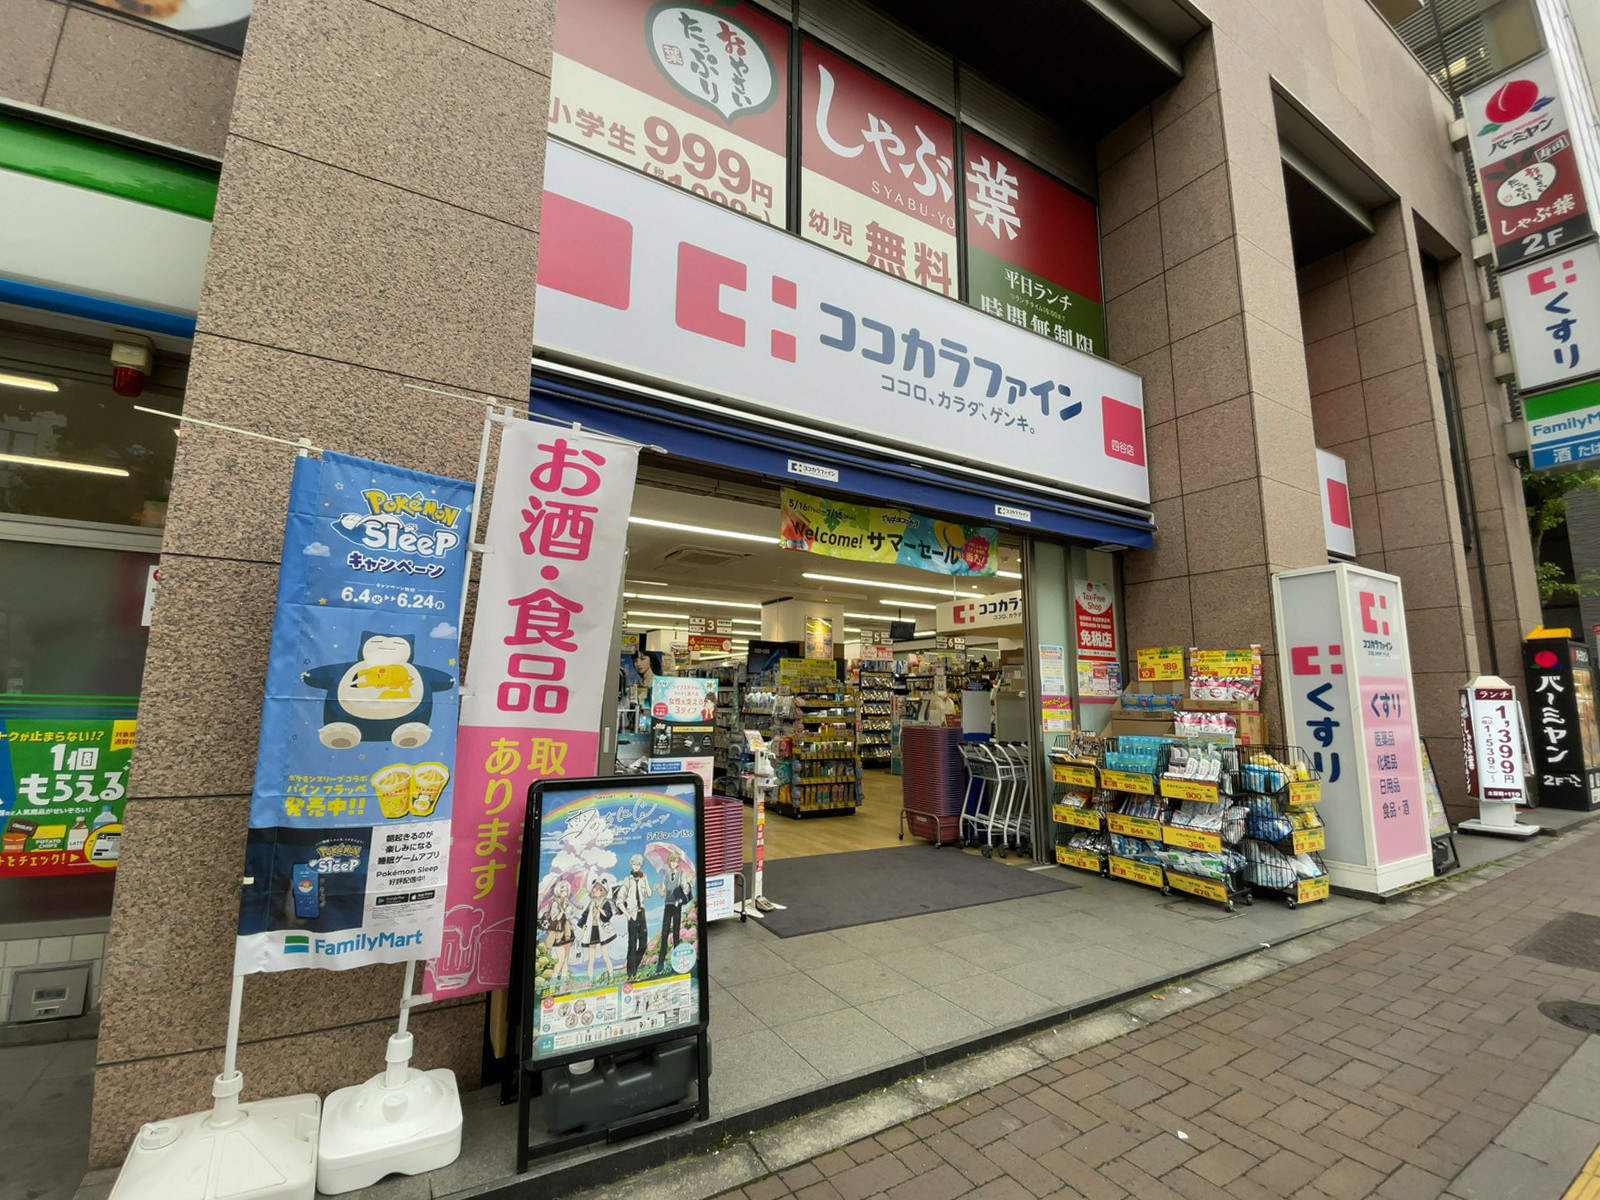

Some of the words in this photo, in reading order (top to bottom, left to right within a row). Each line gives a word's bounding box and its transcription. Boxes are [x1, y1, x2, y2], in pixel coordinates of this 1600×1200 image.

[1488, 117, 1554, 157] バーミヤン
[815, 63, 1022, 242] しゃぶ葉
[1500, 193, 1577, 236] しゃぶ葉
[808, 208, 853, 247] 幼児
[865, 220, 953, 297] 無料
[1521, 227, 1564, 256] 2F
[1004, 267, 1072, 313] 平日ランチ
[1544, 291, 1580, 370] くすり
[819, 301, 1082, 422] ココカラファイン
[881, 373, 1036, 435] ココロ、カラダ、ゲンキ。
[1111, 439, 1136, 457] 四谷店
[793, 521, 864, 550] Welcome!
[866, 531, 960, 566] サマーセール
[347, 550, 447, 580] キャンペーン
[496, 438, 607, 715] お酒・食品
[979, 597, 1022, 616] ココカラ
[1082, 592, 1106, 603] Tax-Free
[1087, 601, 1103, 613] Shop
[707, 620, 715, 631] 3
[873, 632, 880, 642] 5
[1080, 629, 1113, 648] 免税店
[948, 638, 954, 648] 6
[1162, 662, 1178, 671] 189
[1227, 666, 1248, 675] 778
[1370, 692, 1401, 719] くすり
[1478, 689, 1511, 700] ランチ
[1306, 682, 1341, 783] くすり
[1535, 675, 1570, 764] バーミヤン
[50, 743, 100, 771] 1個
[1377, 754, 1399, 771] 化粧品
[18, 771, 126, 806] もらえる
[1380, 777, 1402, 796] 日用品
[1543, 774, 1565, 787] 2F
[470, 737, 522, 901] あります
[376, 868, 416, 878] Pokémon
[417, 865, 439, 874] Sleep
[314, 930, 423, 956] FamilyMart
